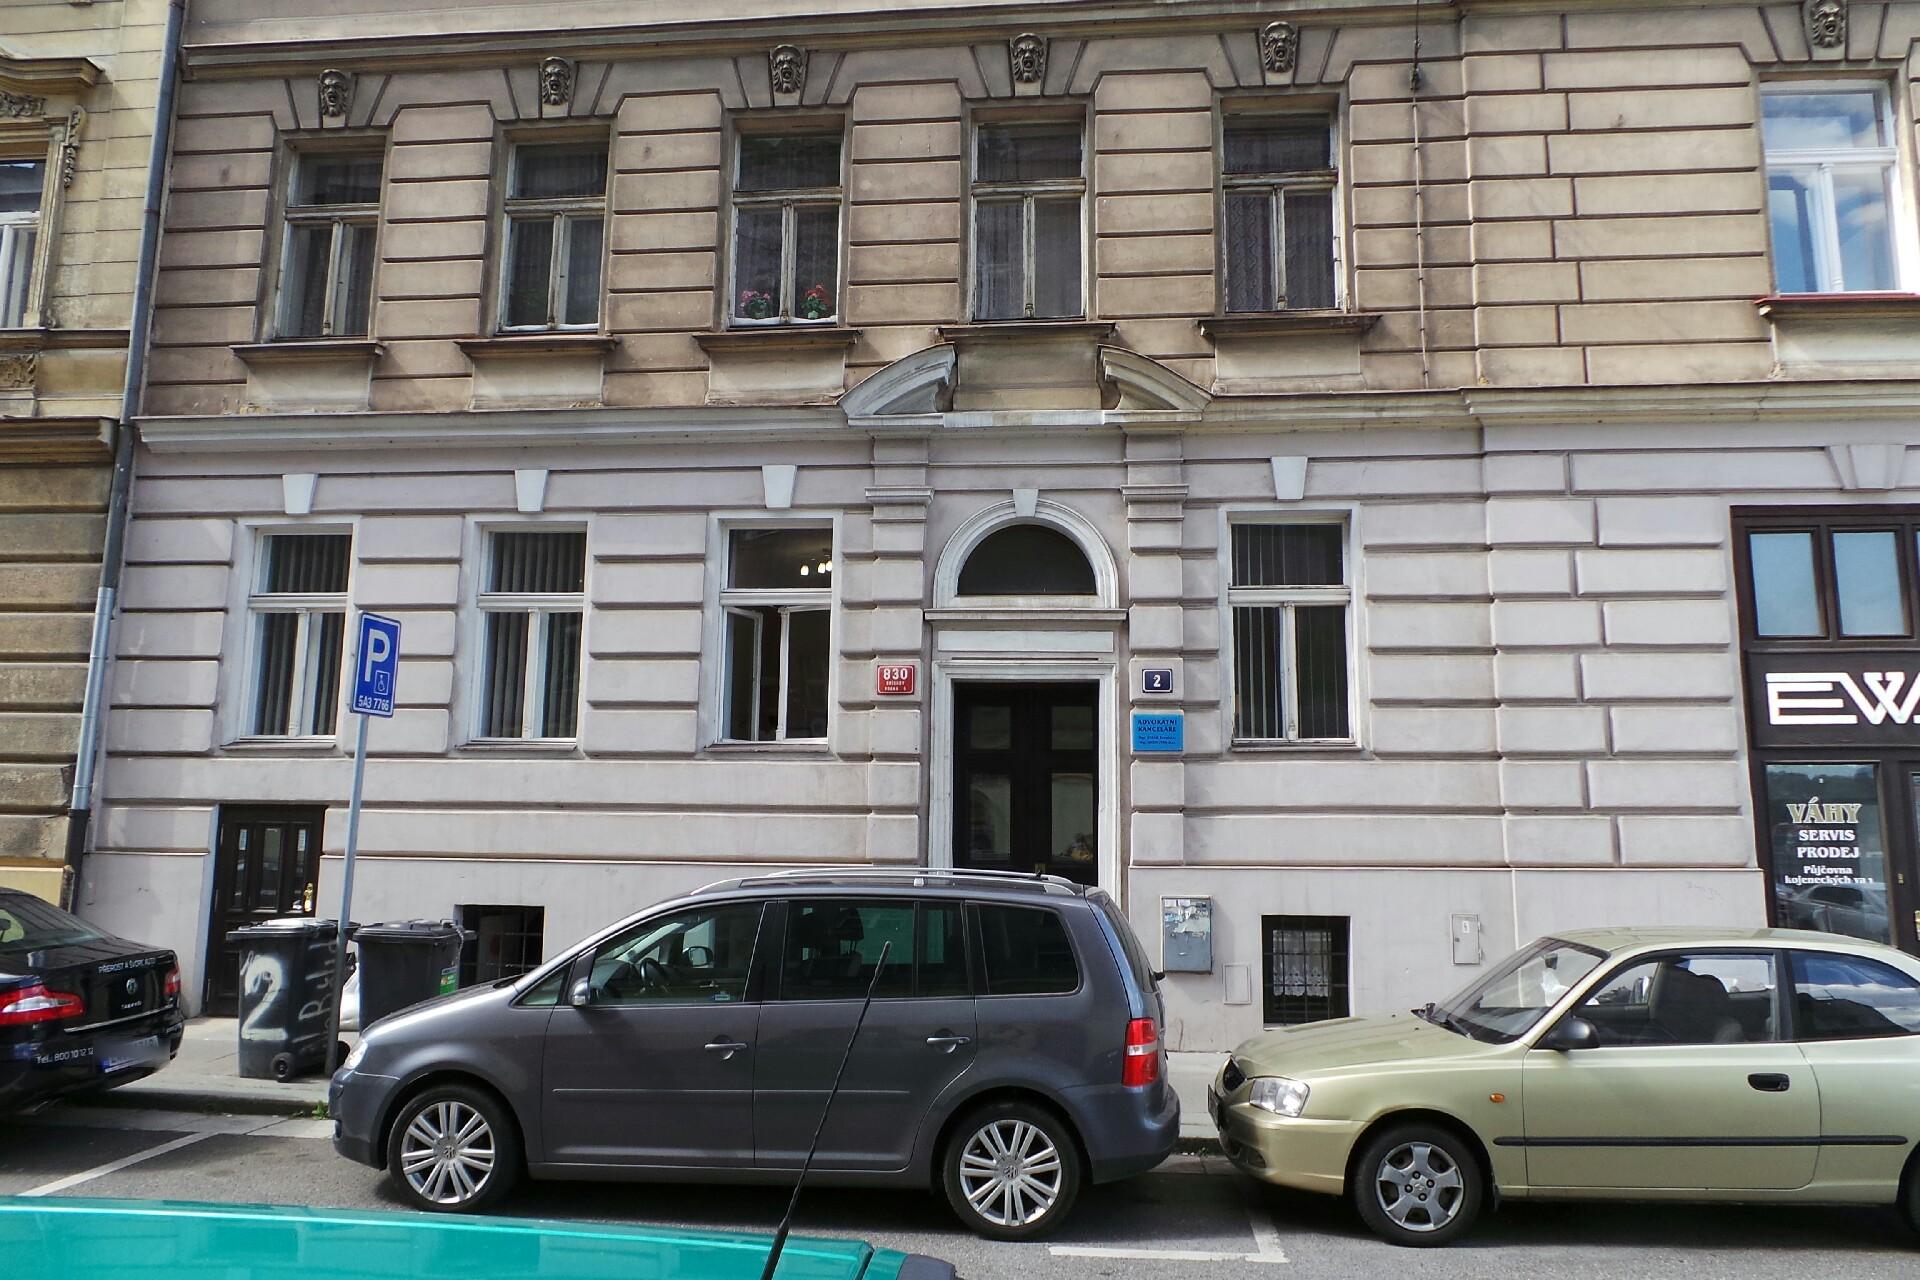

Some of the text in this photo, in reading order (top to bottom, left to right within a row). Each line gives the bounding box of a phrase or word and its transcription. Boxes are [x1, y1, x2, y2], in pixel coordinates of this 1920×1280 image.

[364, 628, 390, 682] P
[883, 668, 908, 680] 830
[1153, 674, 1161, 688] 2
[1786, 796, 1862, 824] VÁHY
[1799, 829, 1856, 841] SERVIS
[1797, 847, 1860, 858] PRODEJ
[1803, 865, 1853, 876] Půjčovna
[1785, 875, 1851, 886] kojeneckých
[241, 954, 288, 1041] 2
